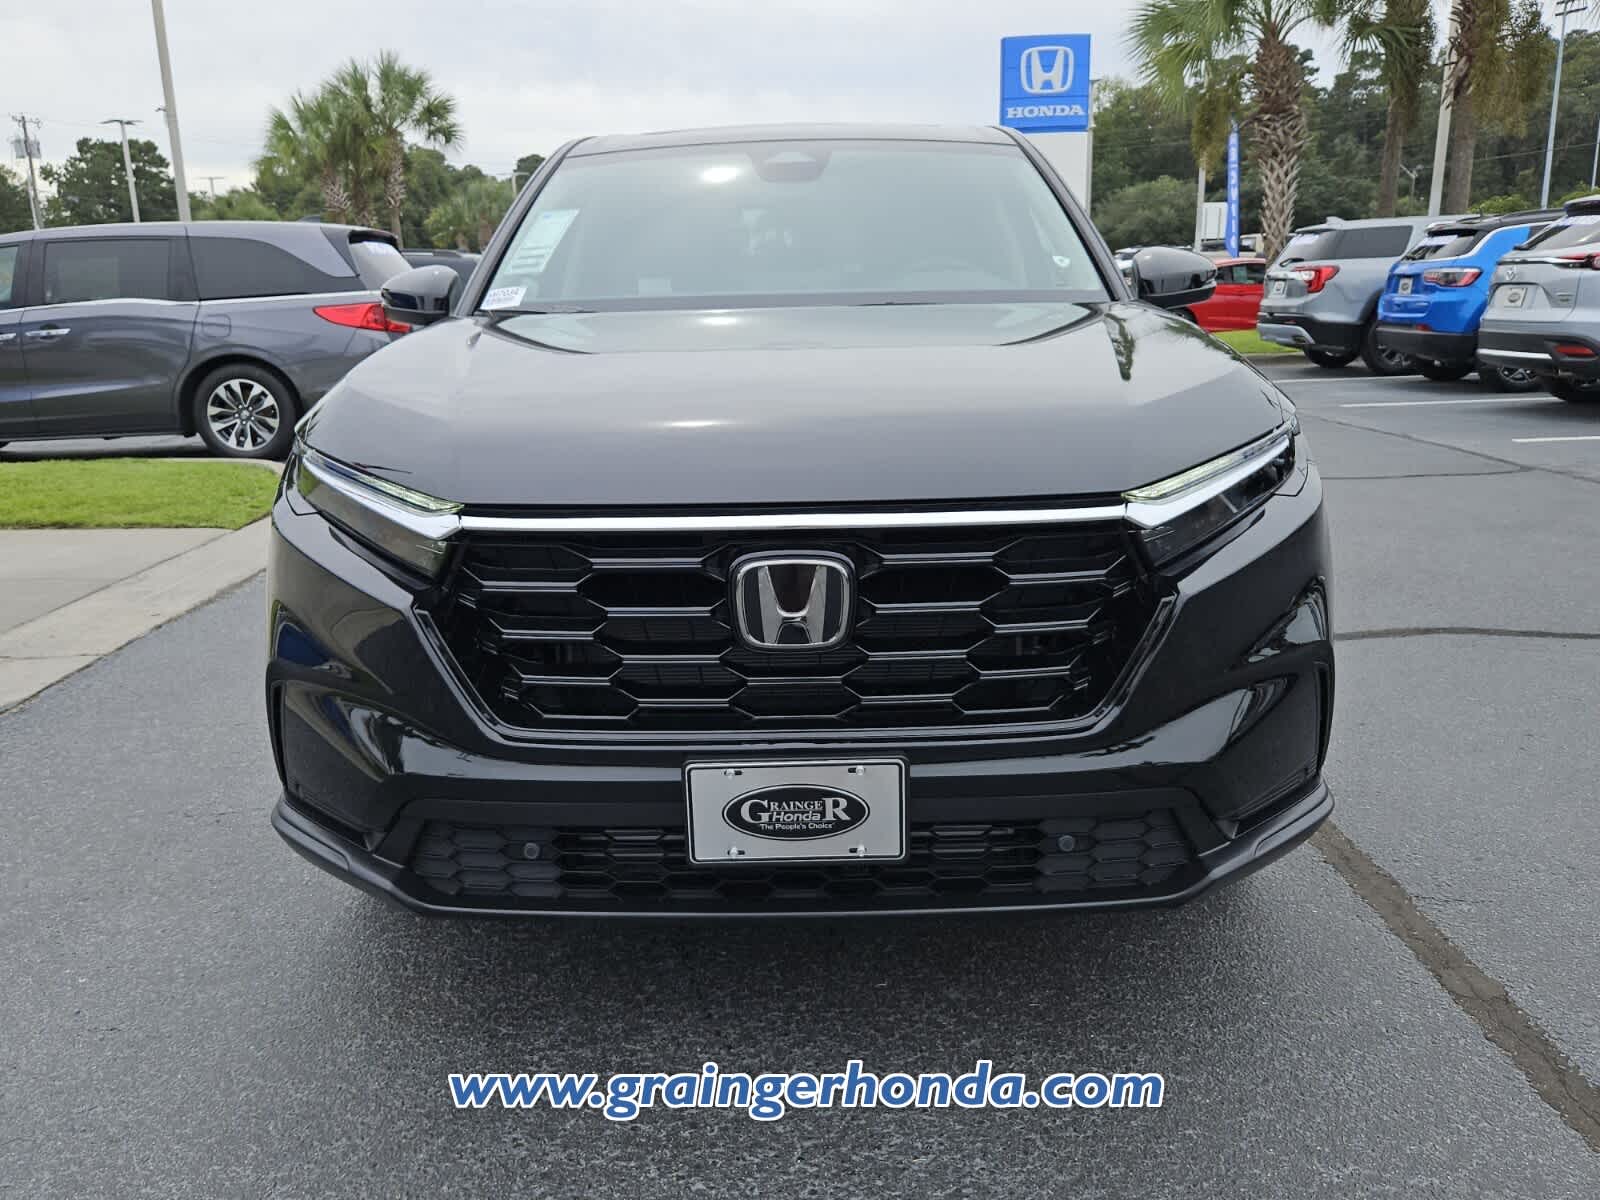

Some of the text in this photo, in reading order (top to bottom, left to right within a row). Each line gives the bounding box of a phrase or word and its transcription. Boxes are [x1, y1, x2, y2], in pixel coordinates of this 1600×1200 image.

[1007, 104, 1085, 119] HONDA
[740, 797, 851, 824] GRAINGER
[772, 811, 821, 822] Honda
[760, 823, 773, 831] The
[775, 823, 807, 831] People's
